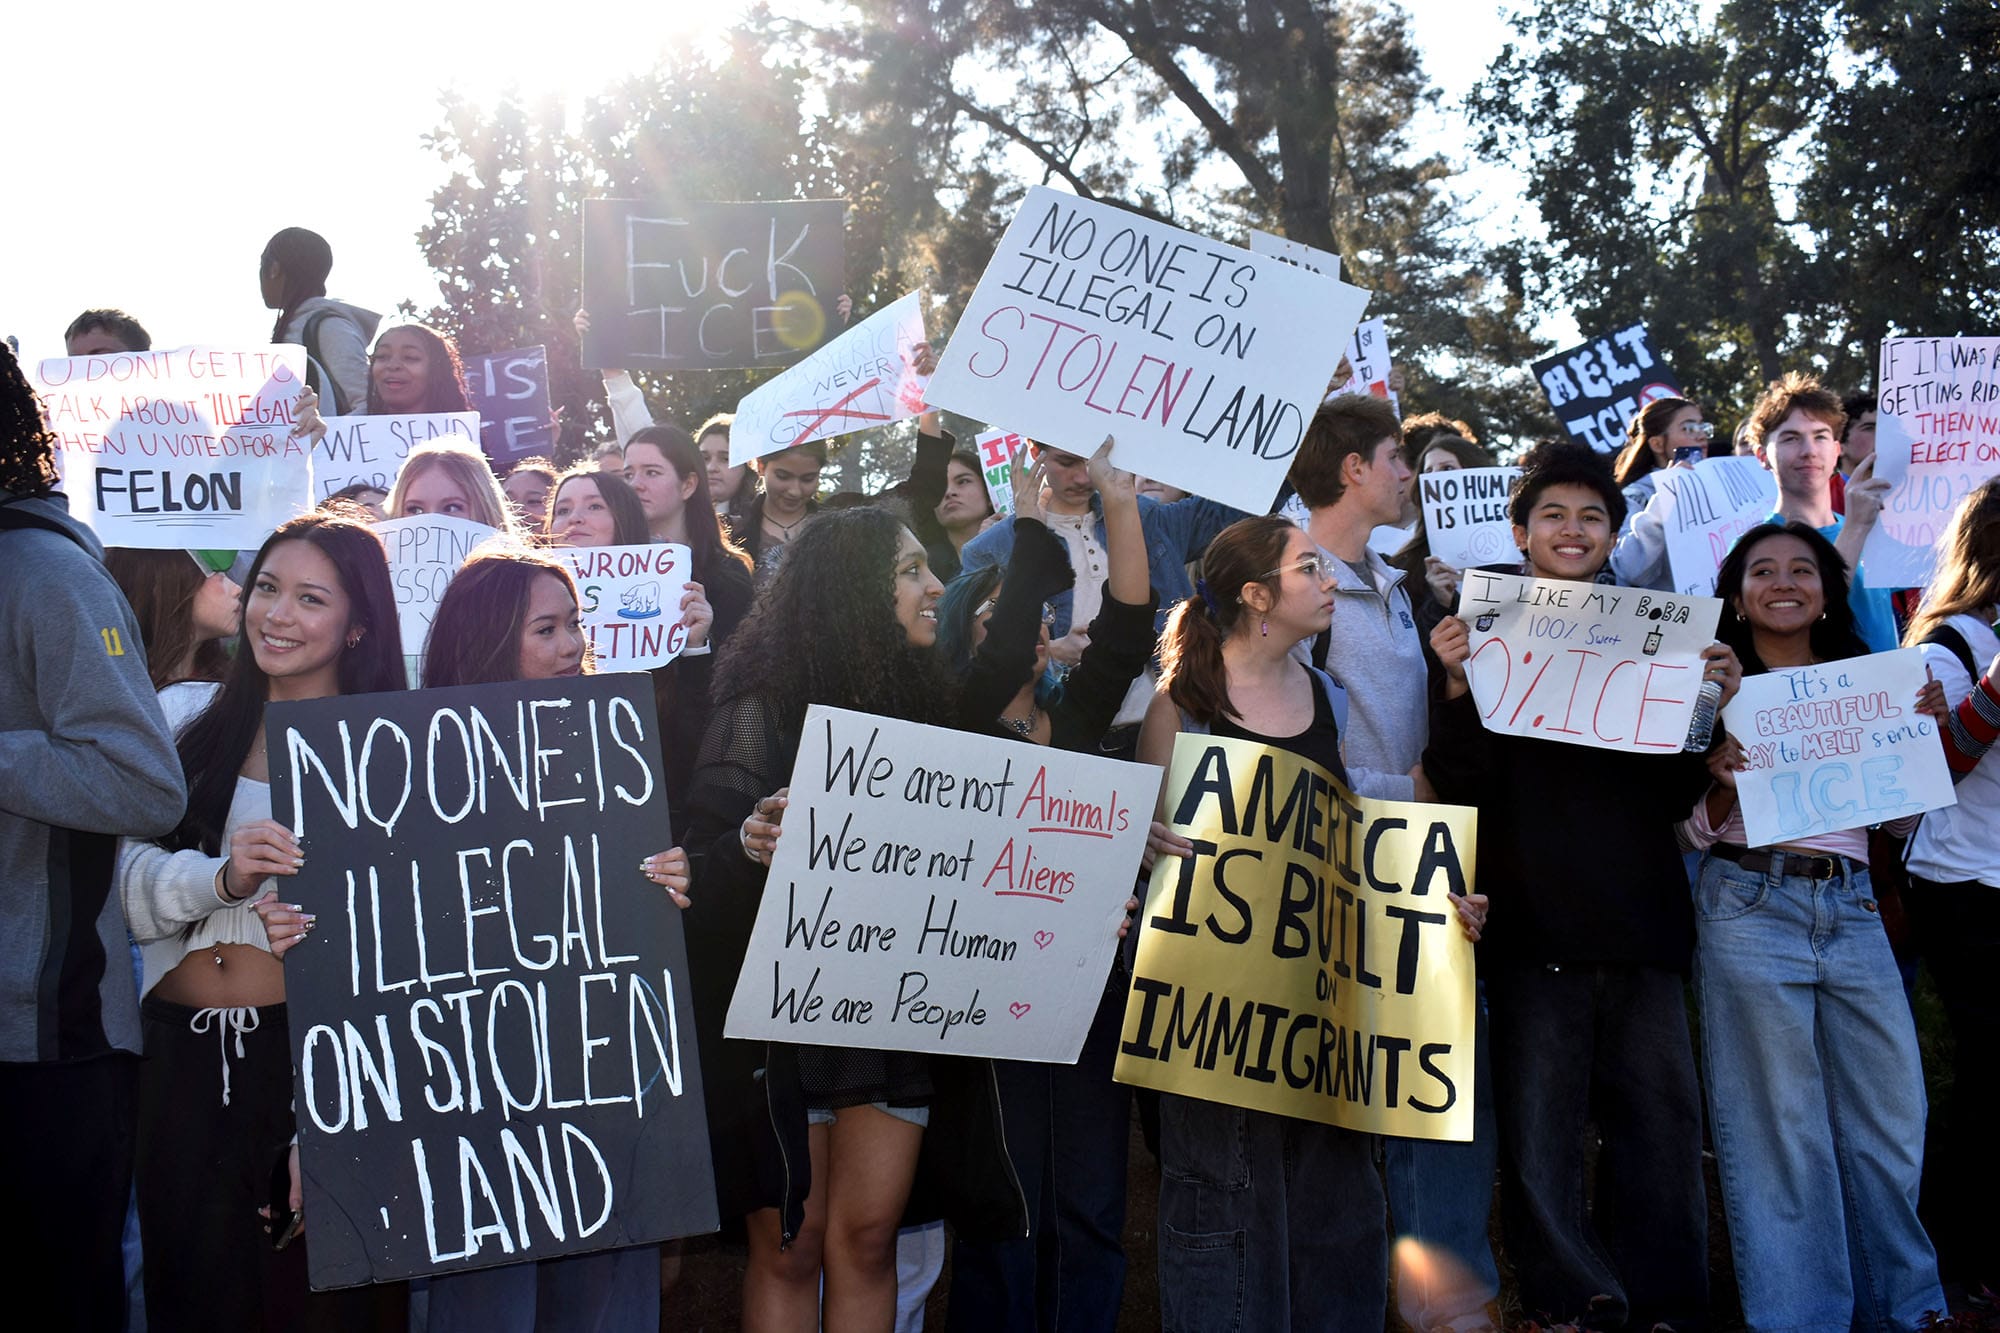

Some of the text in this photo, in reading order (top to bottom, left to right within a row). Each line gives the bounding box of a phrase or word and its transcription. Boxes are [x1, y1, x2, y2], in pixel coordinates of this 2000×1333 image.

[1029, 202, 1256, 309] NO ONE IS
[1003, 252, 1257, 360] ILLEGAL ON
[626, 303, 801, 360] ICE
[40, 350, 294, 386] U DONT GET TO
[813, 356, 894, 396] NEVER
[1541, 324, 1655, 408] MELT
[1882, 340, 1905, 381] IF
[1913, 340, 1941, 376] IT
[1951, 342, 1987, 369] WAS
[968, 306, 1303, 461] STOLEN LAND
[1880, 379, 1999, 416] GETTING RID
[41, 393, 111, 422] TALK
[120, 395, 199, 426] ABOUT
[1915, 412, 1975, 437] THEN
[137, 433, 159, 456] U
[163, 432, 240, 457] VOTED
[240, 433, 278, 456] FOR
[284, 434, 304, 458] A
[321, 422, 378, 463] WE
[981, 433, 1021, 468] IF
[1910, 441, 1971, 464] ELECT
[95, 467, 242, 514] FELON
[1424, 474, 1522, 504] NO HUMA
[1436, 506, 1456, 530] IS
[571, 549, 675, 579] WRONG
[1472, 574, 1503, 603] I
[1516, 583, 1573, 608] LIKE
[1581, 592, 1621, 615] MY
[101, 627, 125, 656] 11
[583, 622, 684, 659] LTING
[1528, 614, 1622, 645] 100% Sweet
[1781, 669, 1854, 704] It's a
[1755, 690, 1903, 738] BEAUTIFUL
[1778, 741, 1800, 764] to
[1801, 727, 1864, 761] MELT
[1872, 720, 1932, 748] some
[286, 697, 655, 838] NO ONE IS
[825, 719, 1129, 833] We are not Animals
[1771, 754, 1908, 835] ICE
[1173, 745, 1467, 896] AMERICA
[808, 807, 1075, 895] We are not Aliens
[346, 834, 640, 997] ILLEGAL
[785, 882, 1017, 961] We are Human
[1150, 838, 1447, 995] IS BUILT
[771, 961, 987, 1040] We are People
[1315, 968, 1338, 1007] ON
[302, 968, 684, 1135] ON STOLEN
[1121, 976, 1457, 1114] IMMIGRANTS
[412, 1122, 614, 1264] LAND
